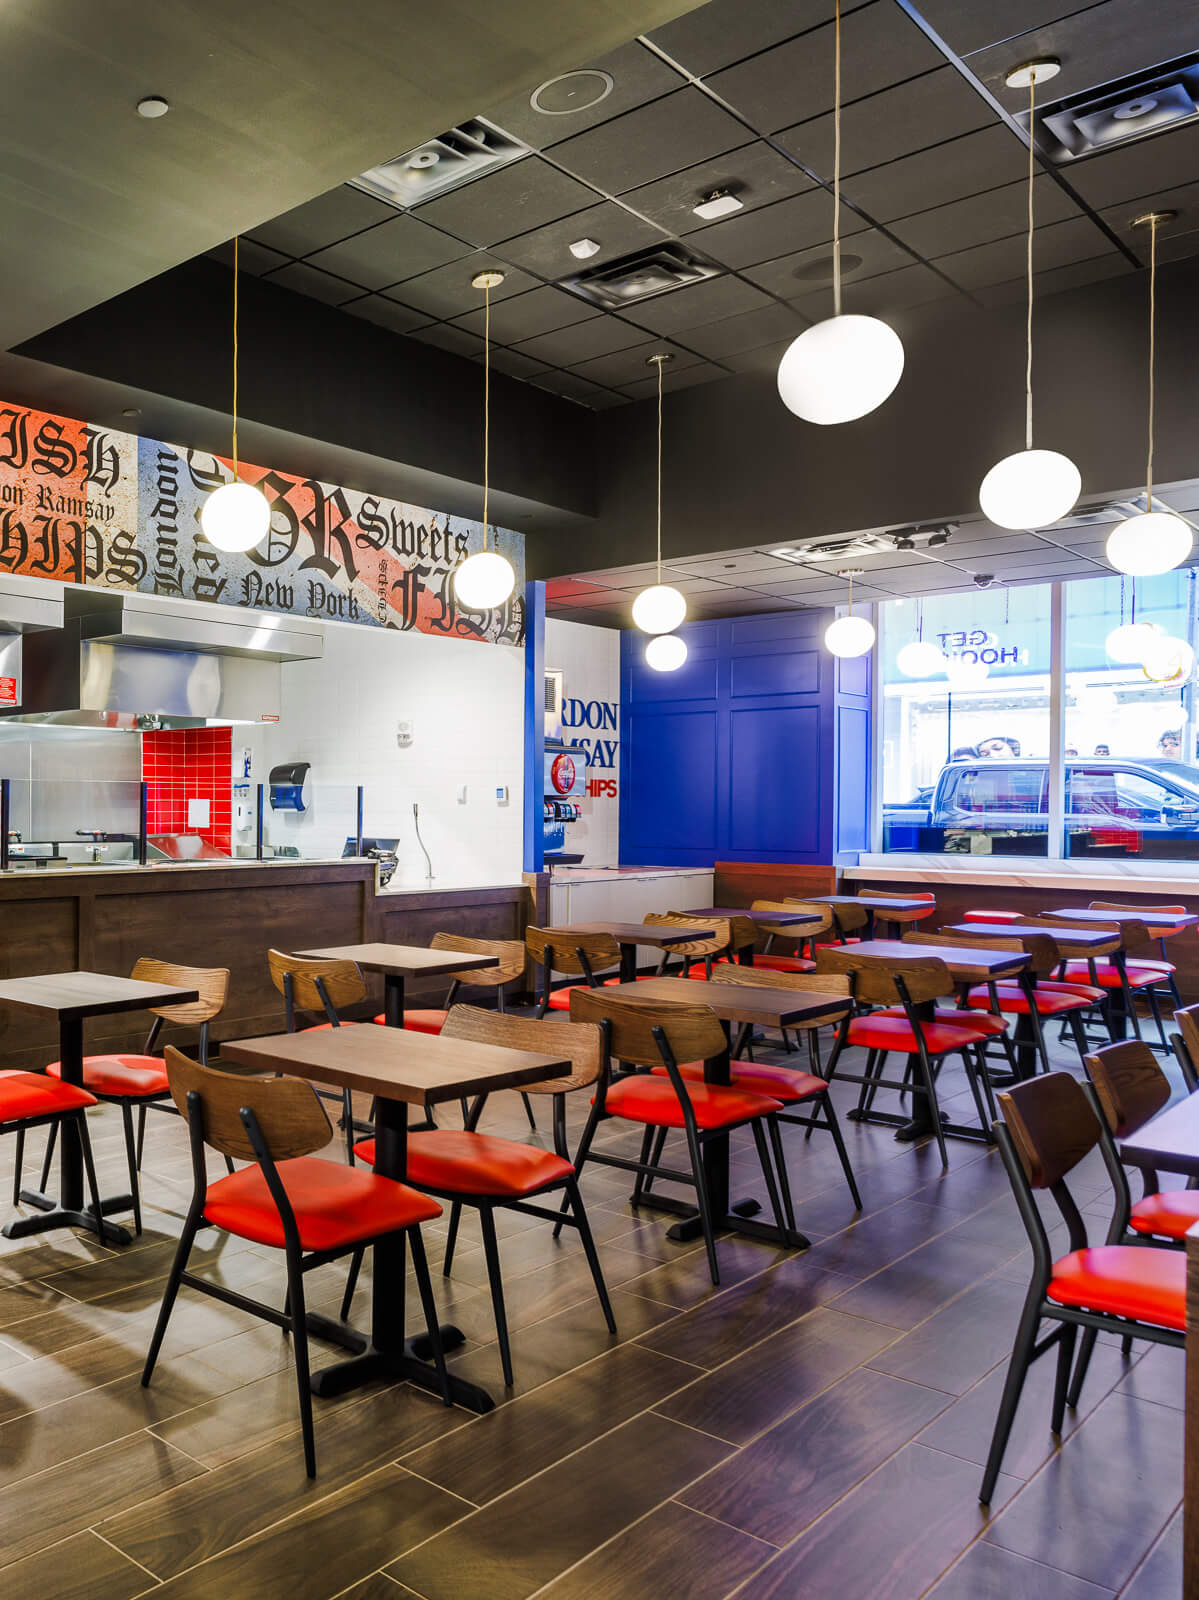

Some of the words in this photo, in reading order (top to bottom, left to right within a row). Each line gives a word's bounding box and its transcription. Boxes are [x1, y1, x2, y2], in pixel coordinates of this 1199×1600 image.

[36, 484, 116, 524] Ramsay
[151, 448, 185, 598] London
[356, 496, 470, 567] Sweets
[238, 570, 294, 609] New
[306, 578, 359, 623] York
[561, 698, 620, 731] RDON
[560, 738, 620, 768] SAY
[585, 779, 617, 798] HIPS
